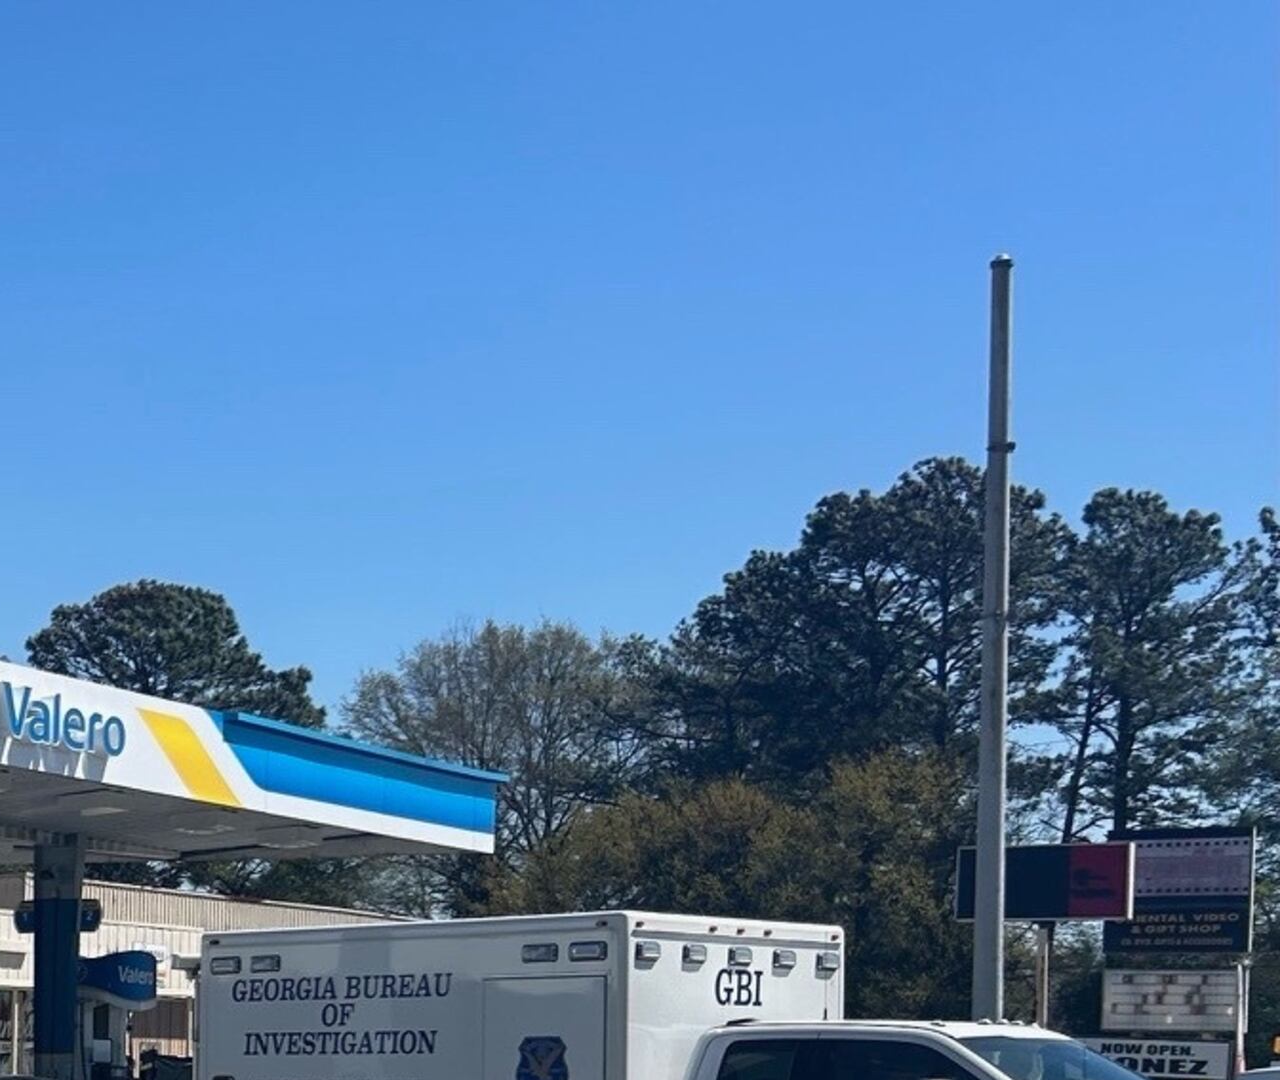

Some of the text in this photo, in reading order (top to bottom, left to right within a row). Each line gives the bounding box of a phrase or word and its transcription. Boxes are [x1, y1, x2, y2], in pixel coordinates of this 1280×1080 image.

[2, 681, 126, 757] Valero
[1178, 923, 1222, 934] SHOP
[1192, 912, 1240, 922] VIDEO
[231, 972, 453, 1002] GEORGIA BUREAU
[714, 968, 763, 1007] GBI
[321, 1002, 355, 1027] OF
[243, 1029, 438, 1056] INVESTIGATION
[1100, 1042, 1143, 1055] NOW
[1113, 1056, 1209, 1075] ONEZ
